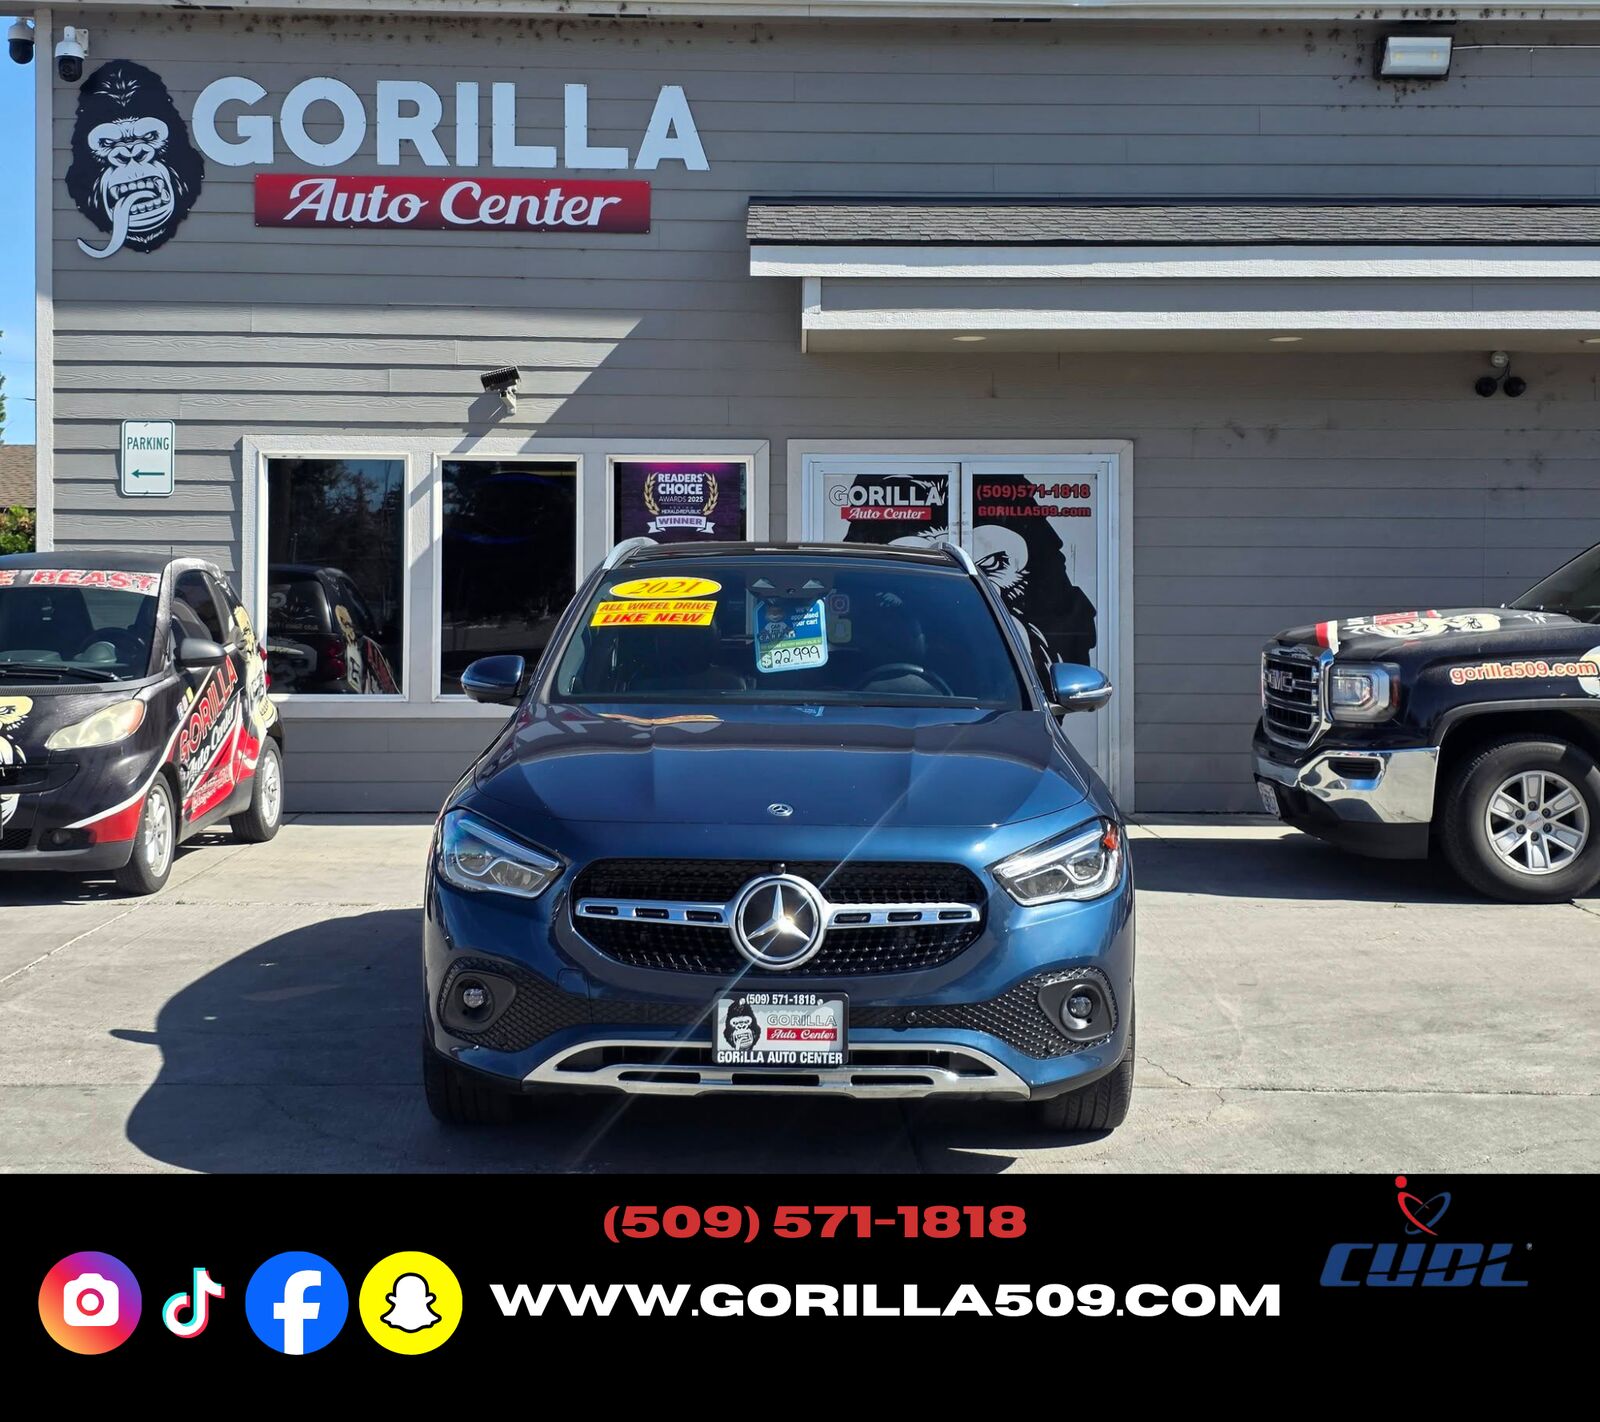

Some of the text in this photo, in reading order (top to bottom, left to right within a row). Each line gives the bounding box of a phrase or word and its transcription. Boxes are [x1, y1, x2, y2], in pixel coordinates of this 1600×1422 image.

[191, 75, 711, 172] GORILLA
[283, 177, 622, 227] Auto Center
[127, 436, 170, 451] PARKING
[657, 473, 704, 482] READERS'
[657, 483, 703, 495] CHOICE
[828, 484, 944, 507] GORILLA
[976, 483, 1091, 501] (509)571-1818
[848, 507, 926, 520] Auto Center
[977, 505, 1092, 517] GORILLA509.com
[658, 517, 703, 526] WINNER
[29, 568, 158, 591] BEAST
[628, 581, 703, 595] 2021
[600, 602, 713, 612] ALL WHEEL DRIVE
[601, 612, 705, 624] LIKE NEW
[1449, 660, 1599, 685] gorilla509.com
[179, 654, 239, 766] GORILLA
[746, 993, 816, 1006] (509) 571-1818
[766, 1013, 838, 1027] GORILLA
[770, 1029, 836, 1040] Auto Center
[767, 1051, 797, 1064] AUTO
[799, 1052, 843, 1064] CENTER
